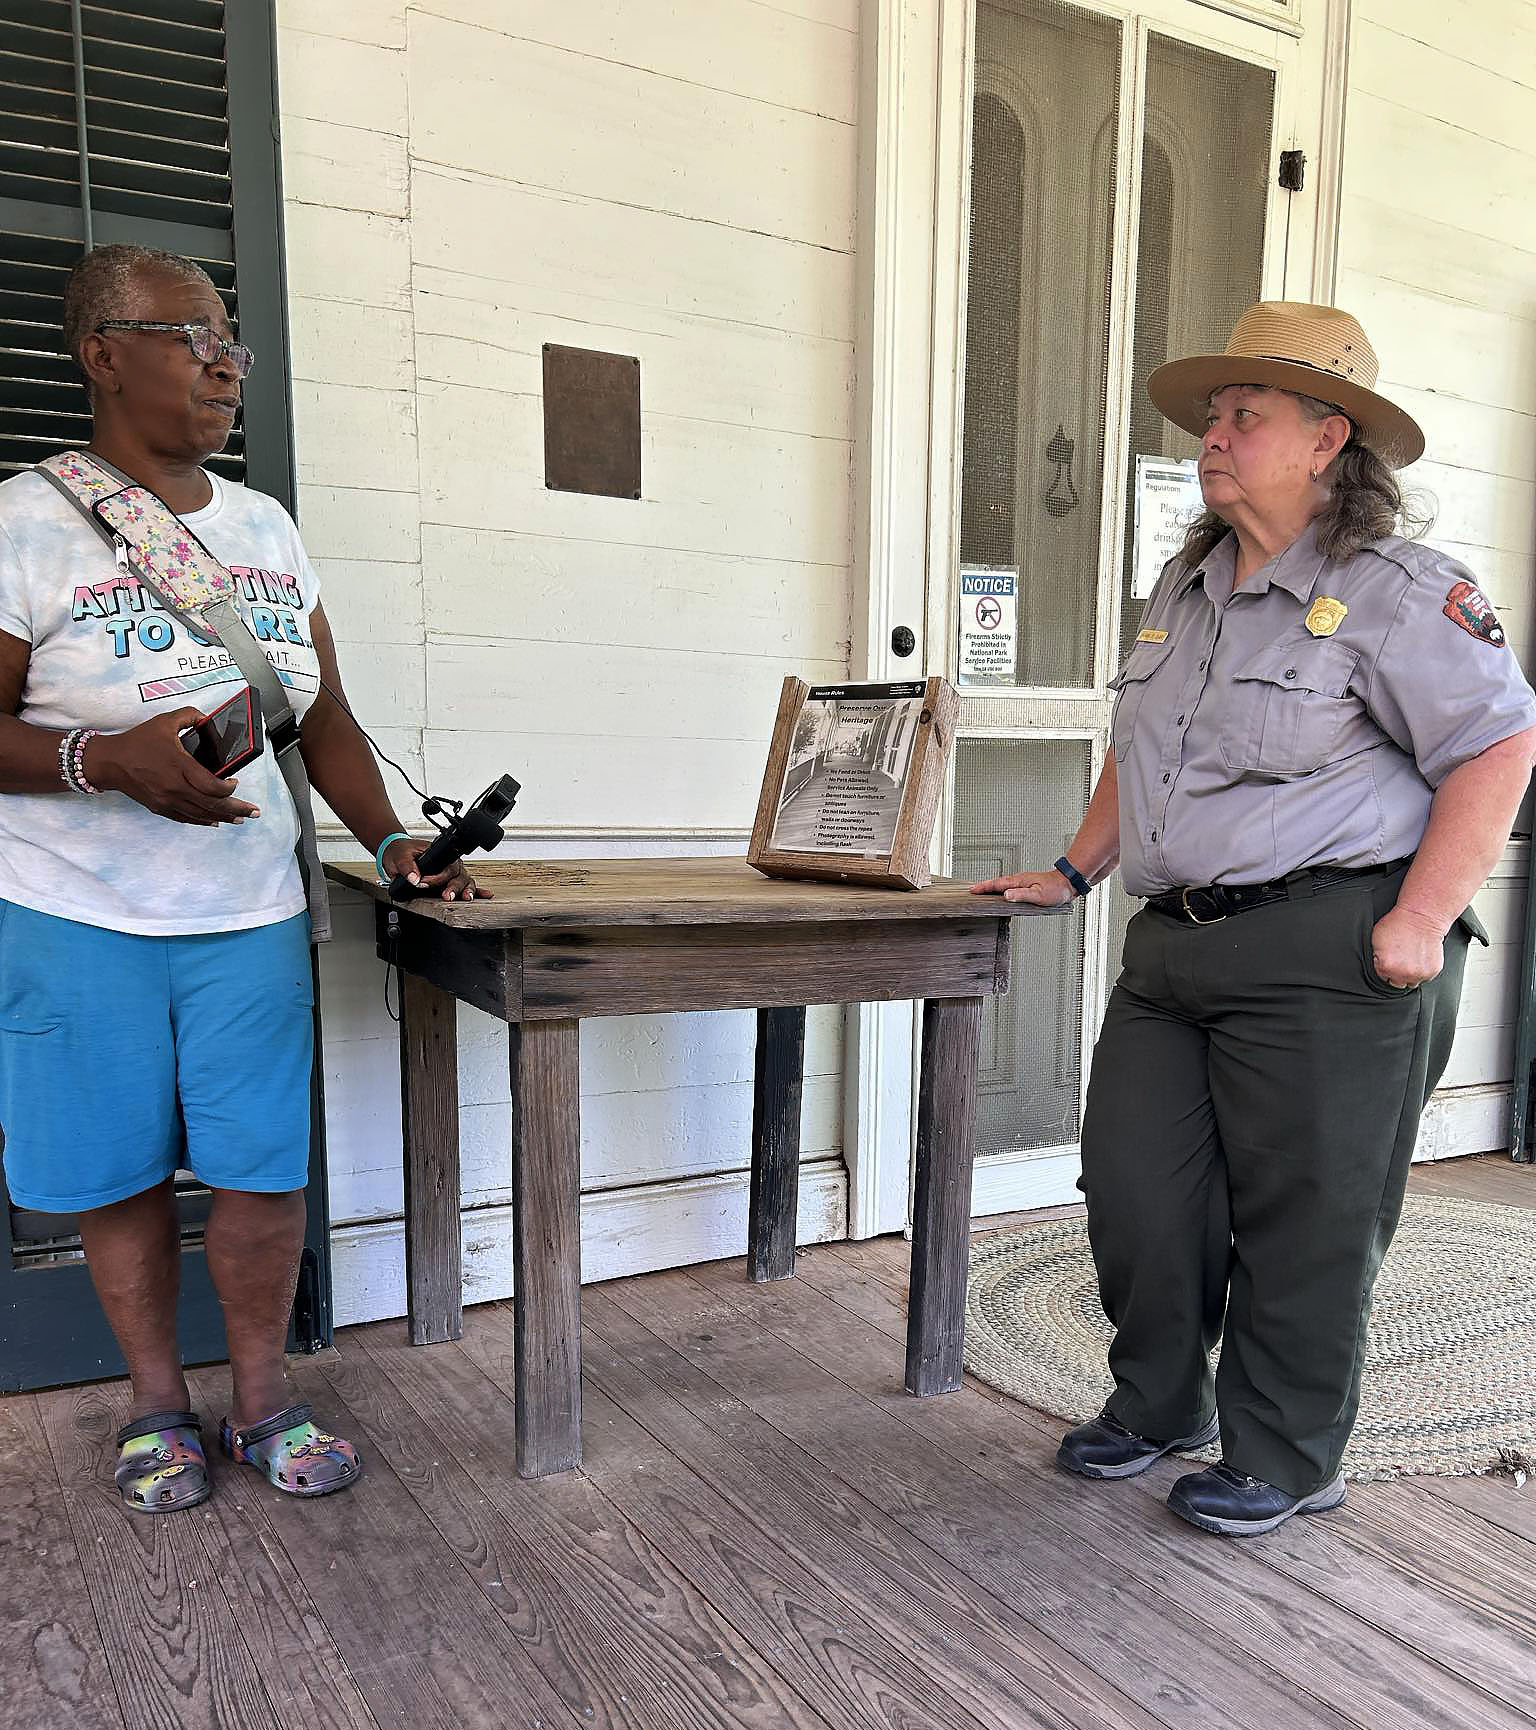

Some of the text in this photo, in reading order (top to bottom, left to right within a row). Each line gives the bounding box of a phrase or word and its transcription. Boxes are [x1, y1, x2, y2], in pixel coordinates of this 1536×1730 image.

[964, 578, 1012, 593] NOTICE
[72, 566, 304, 621] ATTTING
[106, 615, 176, 659] TO
[991, 633, 1011, 641] Strictly
[265, 650, 301, 667] AIT...
[841, 716, 874, 725] Heritage
[840, 817, 865, 825] doorways
[817, 832, 849, 840] Photography
